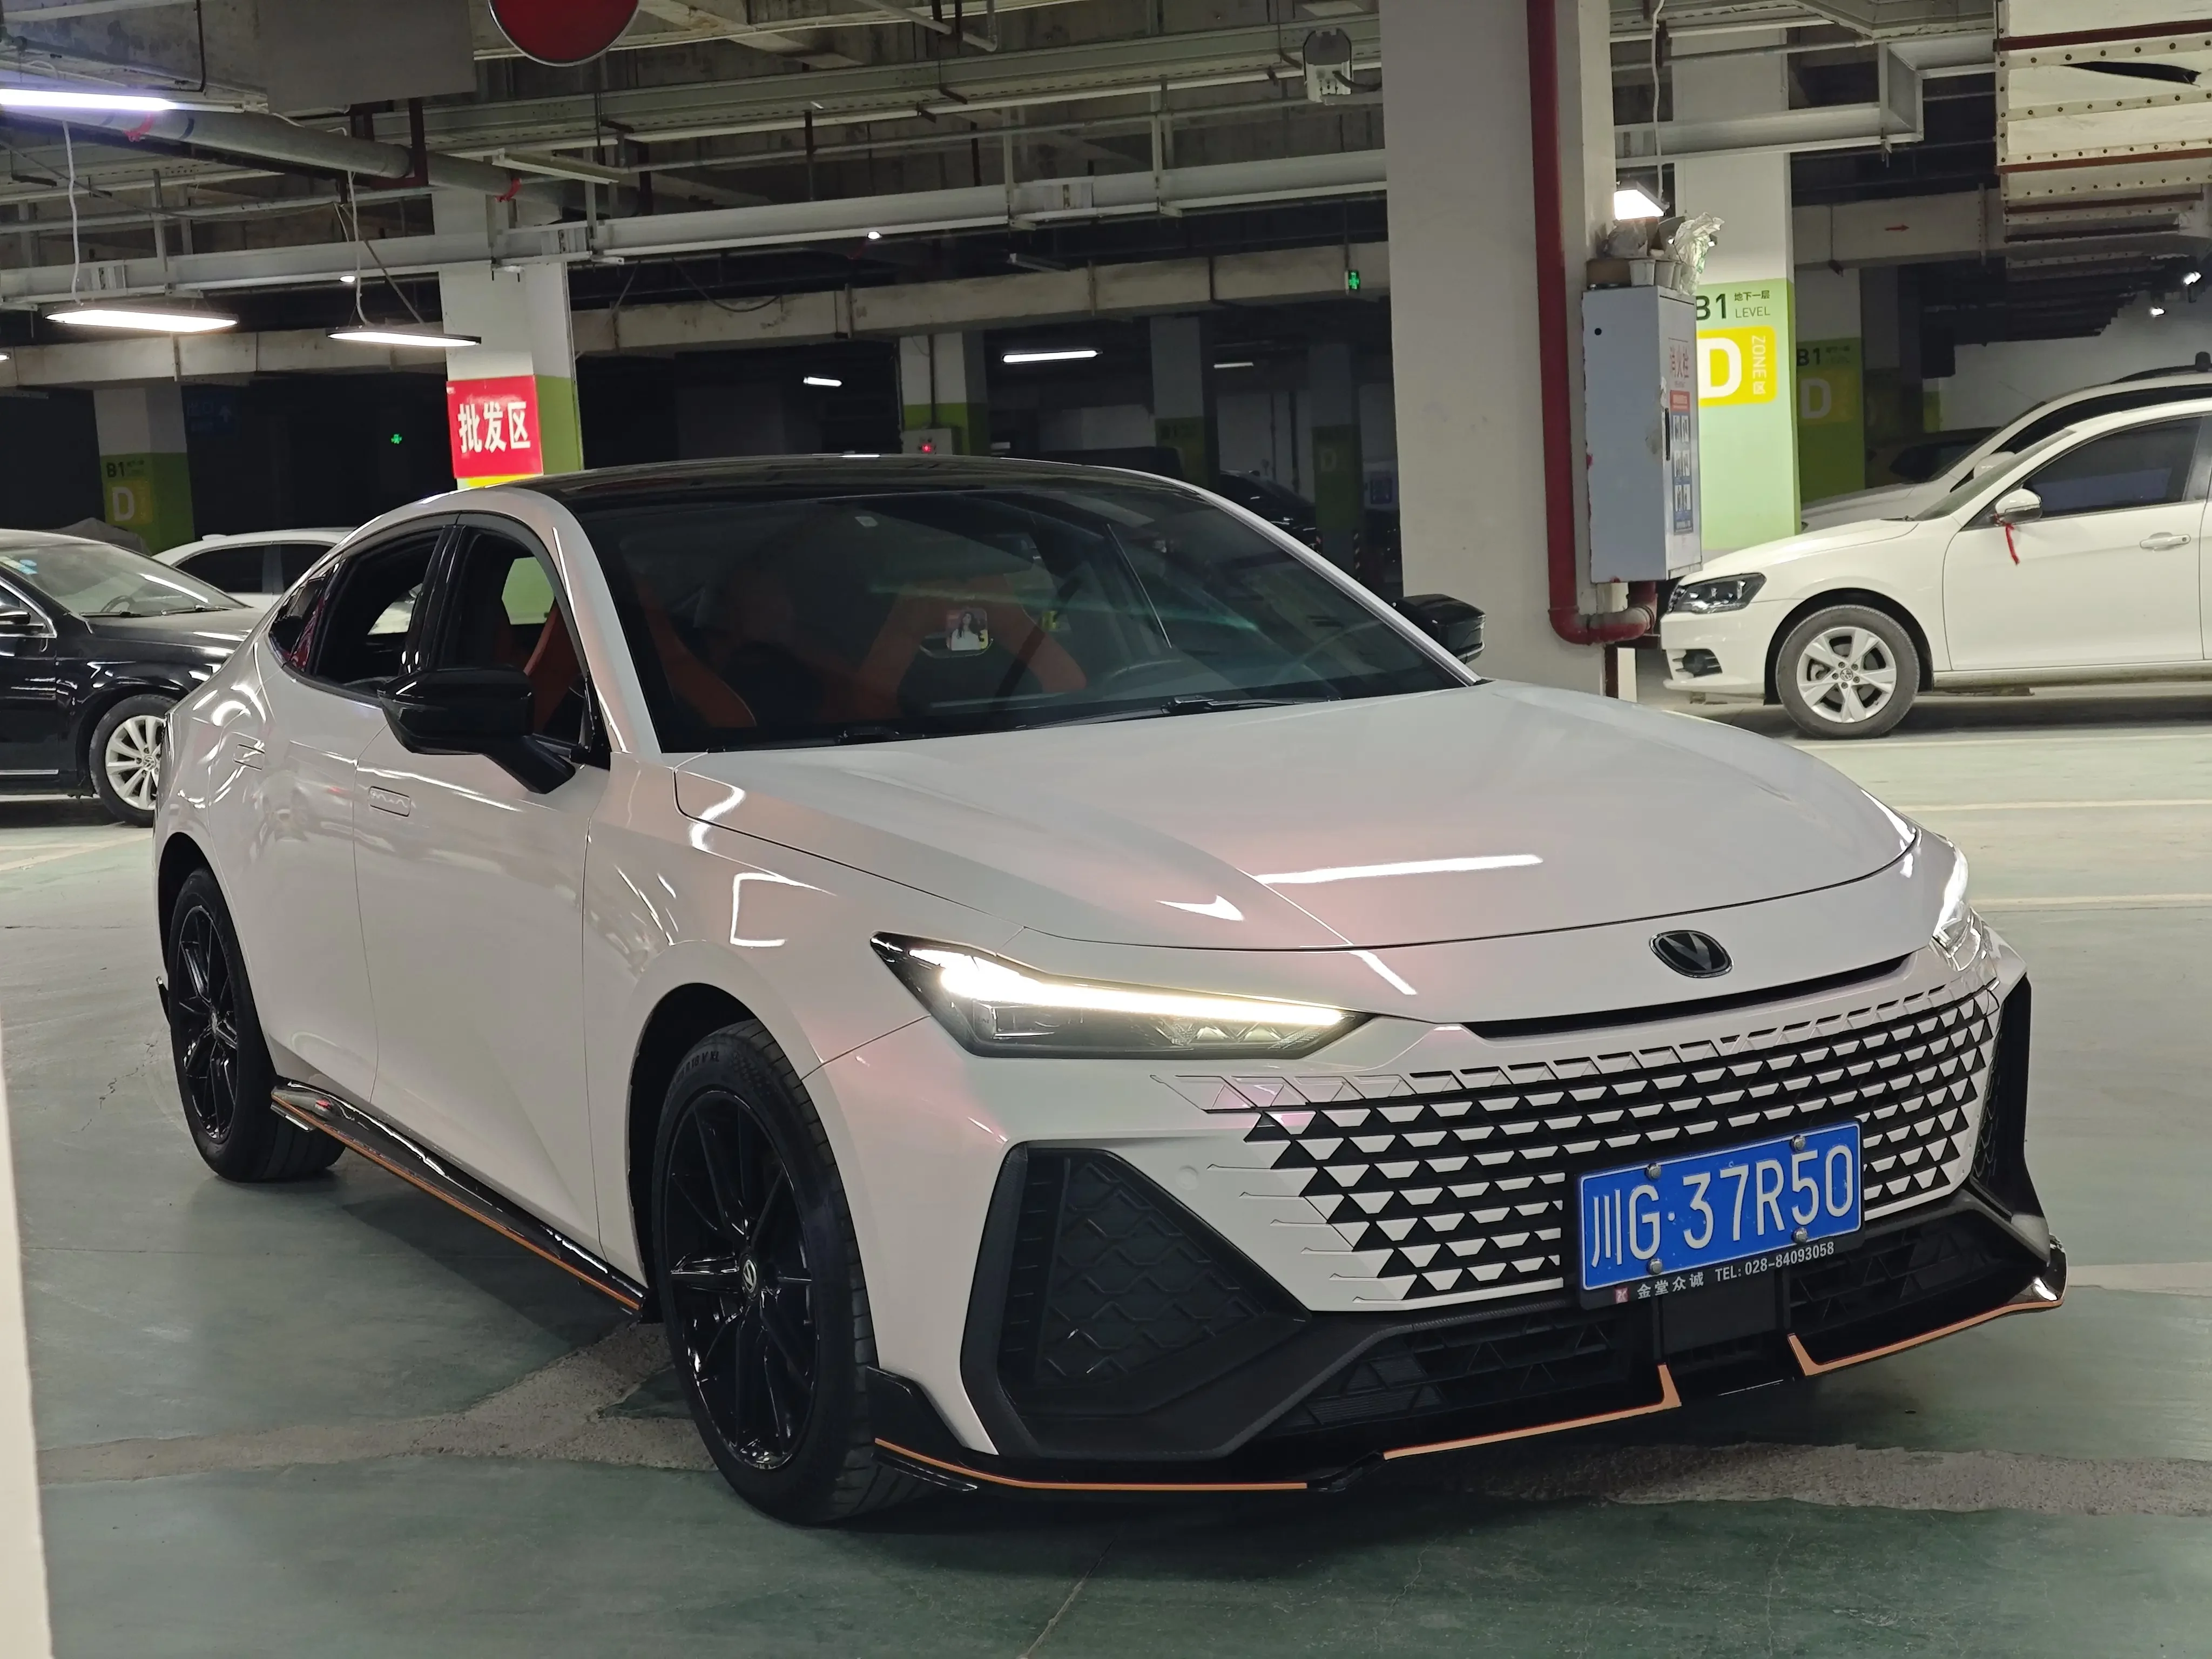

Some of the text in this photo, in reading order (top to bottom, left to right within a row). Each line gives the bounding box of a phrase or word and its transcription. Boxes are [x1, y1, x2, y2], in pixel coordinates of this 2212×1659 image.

[1696, 293, 1727, 320] B1
[1734, 290, 1770, 301] 地下一层
[1735, 306, 1770, 318] LEVEL
[1697, 338, 1742, 399] D
[1752, 335, 1767, 395] ZONE 区
[1797, 347, 1820, 366] B1
[1800, 377, 1832, 419] D
[457, 401, 531, 453] 批发区
[106, 462, 125, 478] B1
[112, 487, 134, 522] D
[1591, 1144, 1853, 1268] 川G·37R50
[1637, 1271, 1704, 1299] 金堂众诚
[1715, 1266, 1742, 1282] TEL:
[1745, 1242, 1835, 1275] 028-84093058
